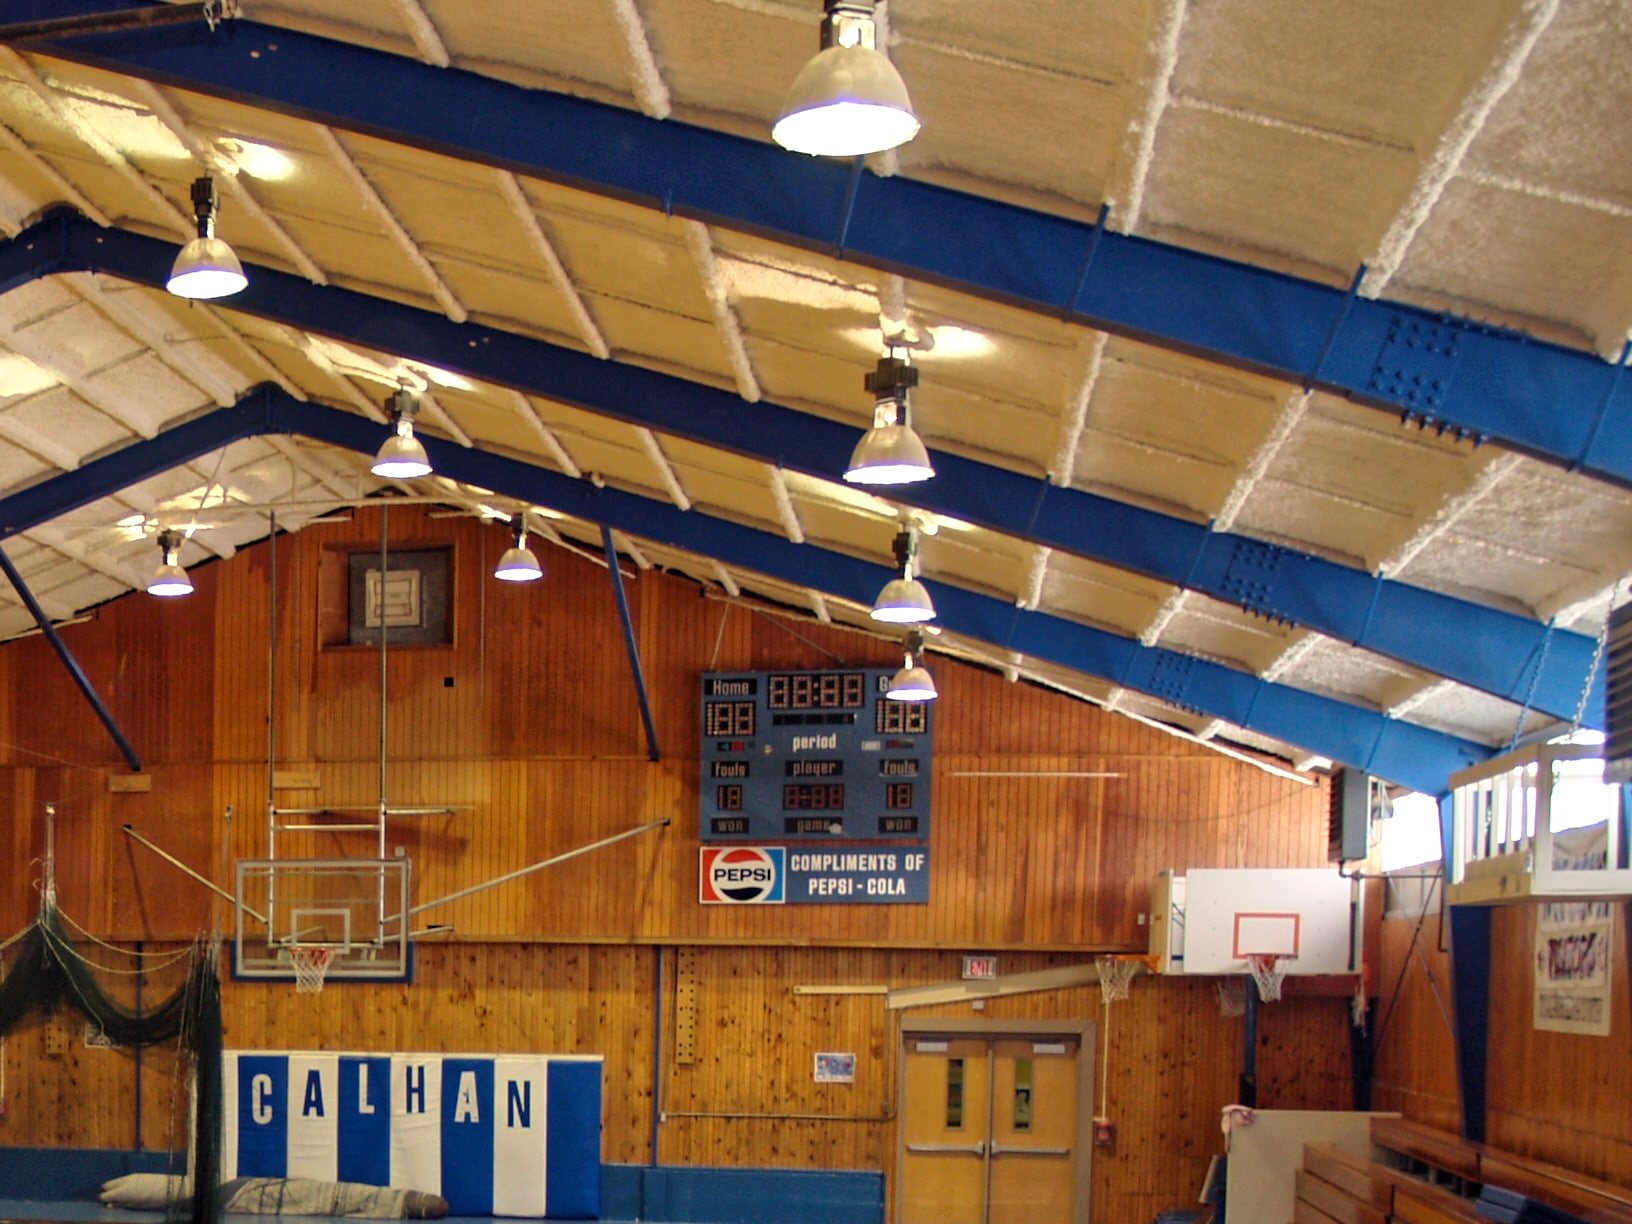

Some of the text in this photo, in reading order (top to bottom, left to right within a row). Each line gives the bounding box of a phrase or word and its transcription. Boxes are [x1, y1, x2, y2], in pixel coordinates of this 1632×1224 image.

[713, 679, 749, 695] Home
[792, 732, 837, 753] period
[715, 762, 746, 777] fouls
[792, 760, 836, 776] player
[884, 759, 915, 773] fouls
[718, 819, 744, 831] won
[886, 819, 911, 831] won
[791, 854, 925, 872] COMPLIMENTS OF
[714, 868, 771, 881] PEPSI
[809, 878, 852, 895] PEPSI
[867, 877, 906, 894] COLA
[252, 1063, 531, 1128] CALHAN
